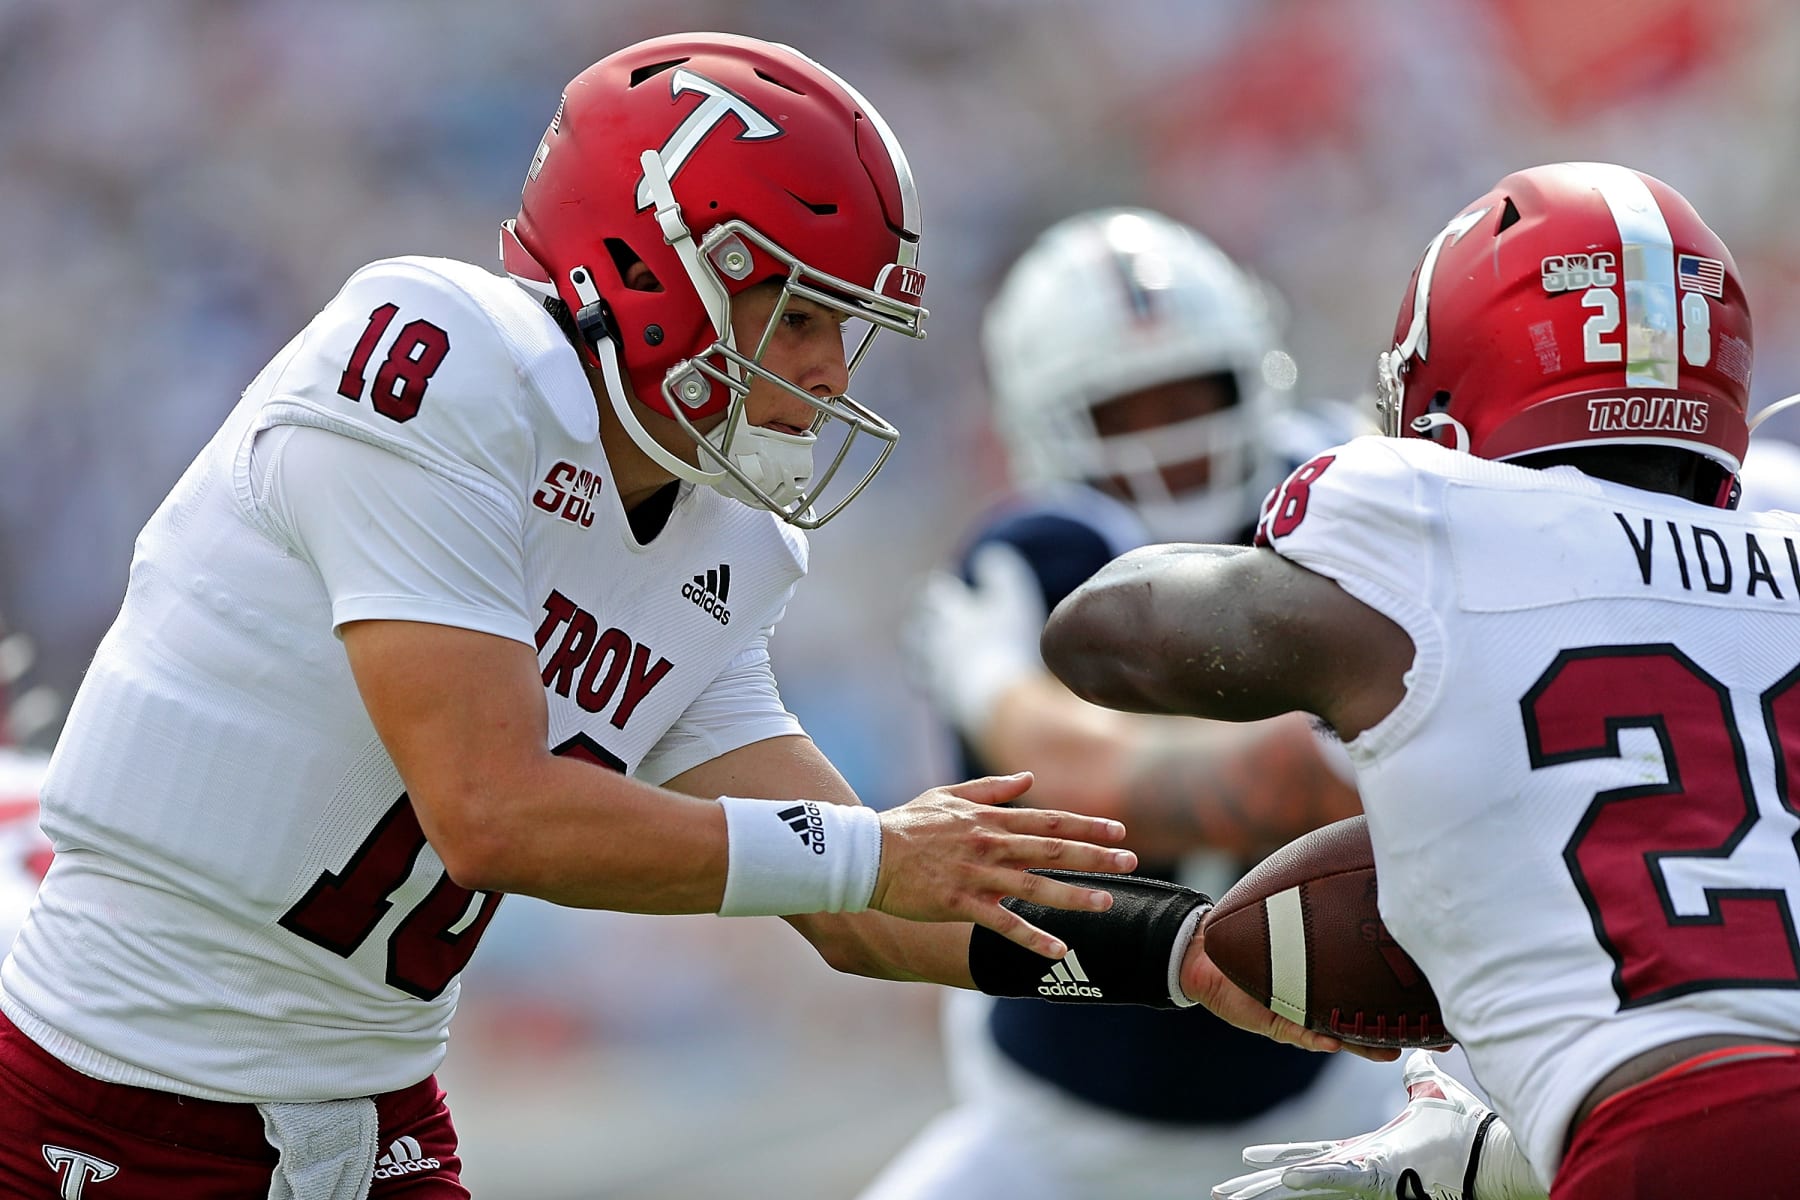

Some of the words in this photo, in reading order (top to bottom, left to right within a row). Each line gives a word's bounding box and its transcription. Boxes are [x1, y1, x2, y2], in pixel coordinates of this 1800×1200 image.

[635, 67, 787, 214] T
[1541, 252, 1617, 292] SBC
[337, 302, 451, 424] 18
[1587, 397, 1709, 434] TROJANS
[532, 459, 602, 528] SBC
[681, 583, 731, 625] adidas
[534, 589, 675, 730] TROY
[805, 802, 825, 855] adidas
[1519, 643, 1800, 1014] 2
[1037, 981, 1103, 998] adidas
[374, 1157, 441, 1179] adidas
